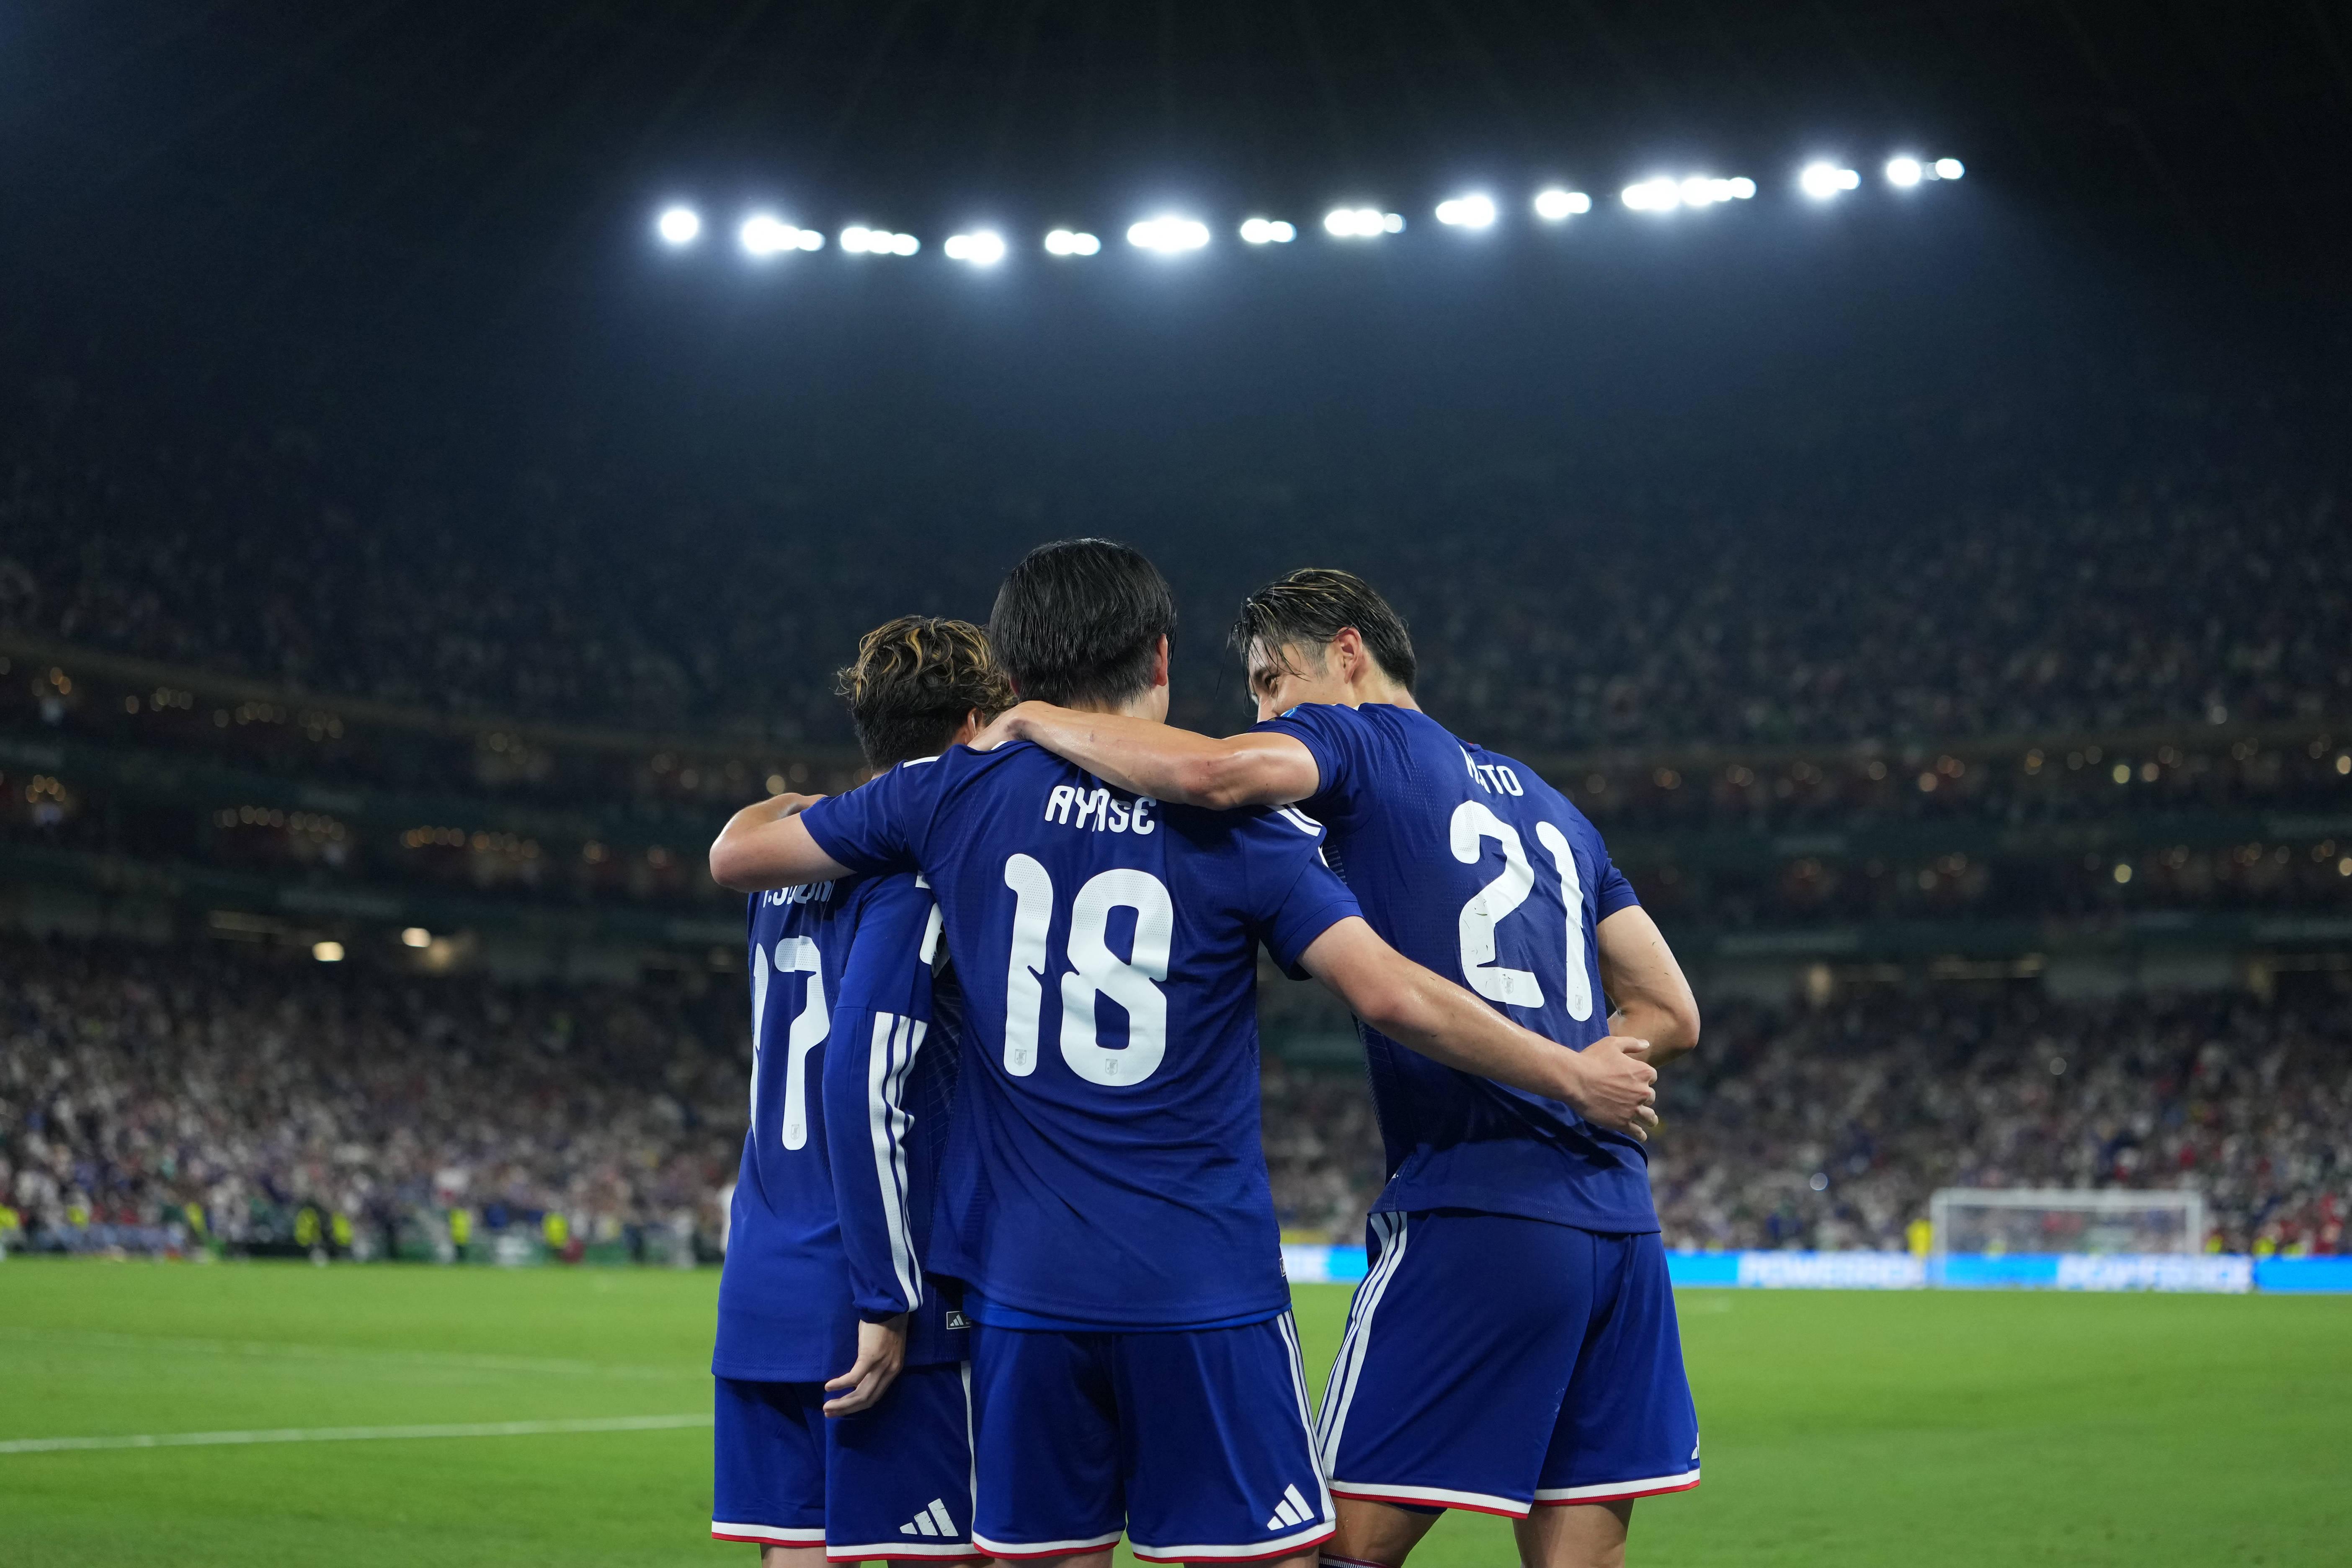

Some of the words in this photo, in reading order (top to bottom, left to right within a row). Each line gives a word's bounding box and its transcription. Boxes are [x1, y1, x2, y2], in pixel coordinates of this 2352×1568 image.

[1044, 785, 1156, 835] AYASE
[1450, 800, 1592, 1021] 21
[750, 935, 830, 1150] 17
[1003, 853, 1173, 1086] 18
